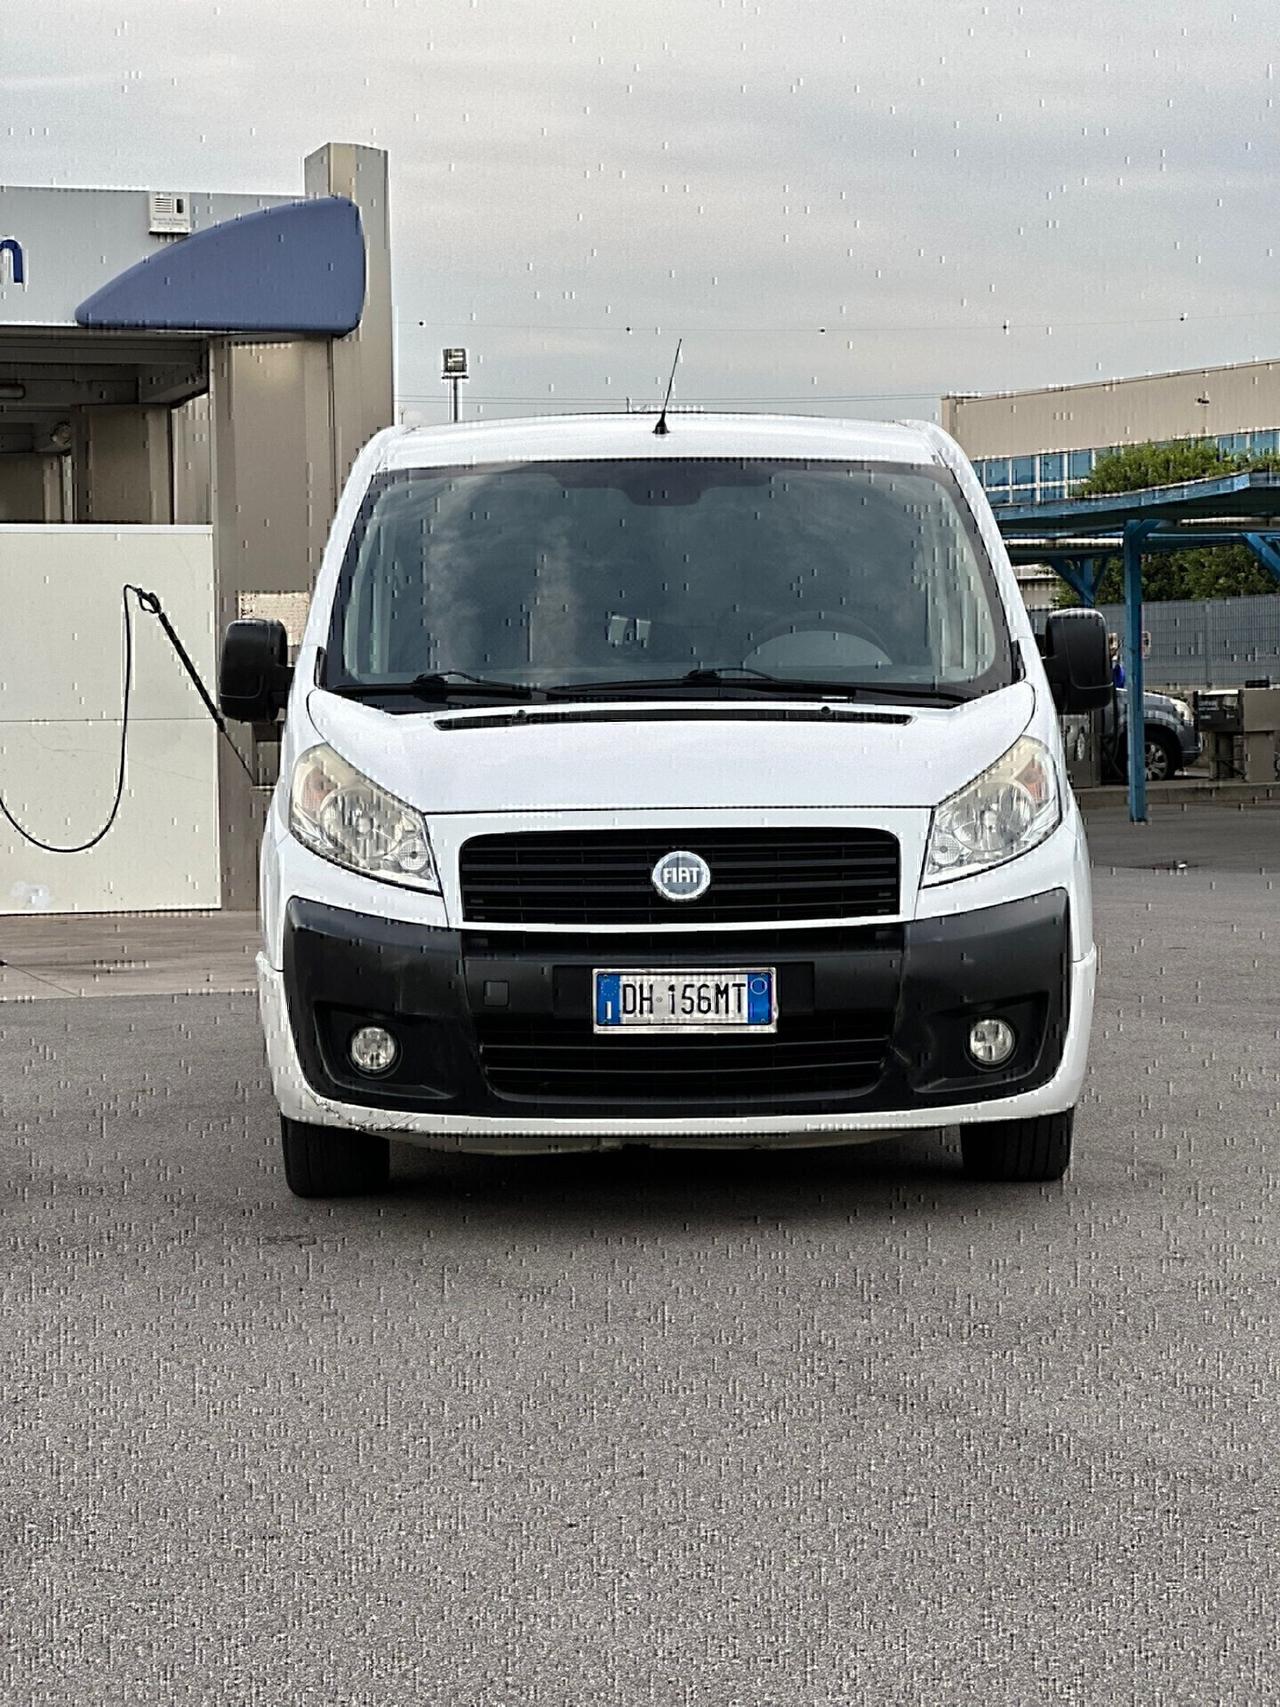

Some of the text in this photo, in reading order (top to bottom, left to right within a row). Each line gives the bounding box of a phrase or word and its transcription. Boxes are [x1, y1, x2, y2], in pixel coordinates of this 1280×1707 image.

[663, 867, 700, 883] FIAT
[622, 983, 746, 1015] DH 156MT
